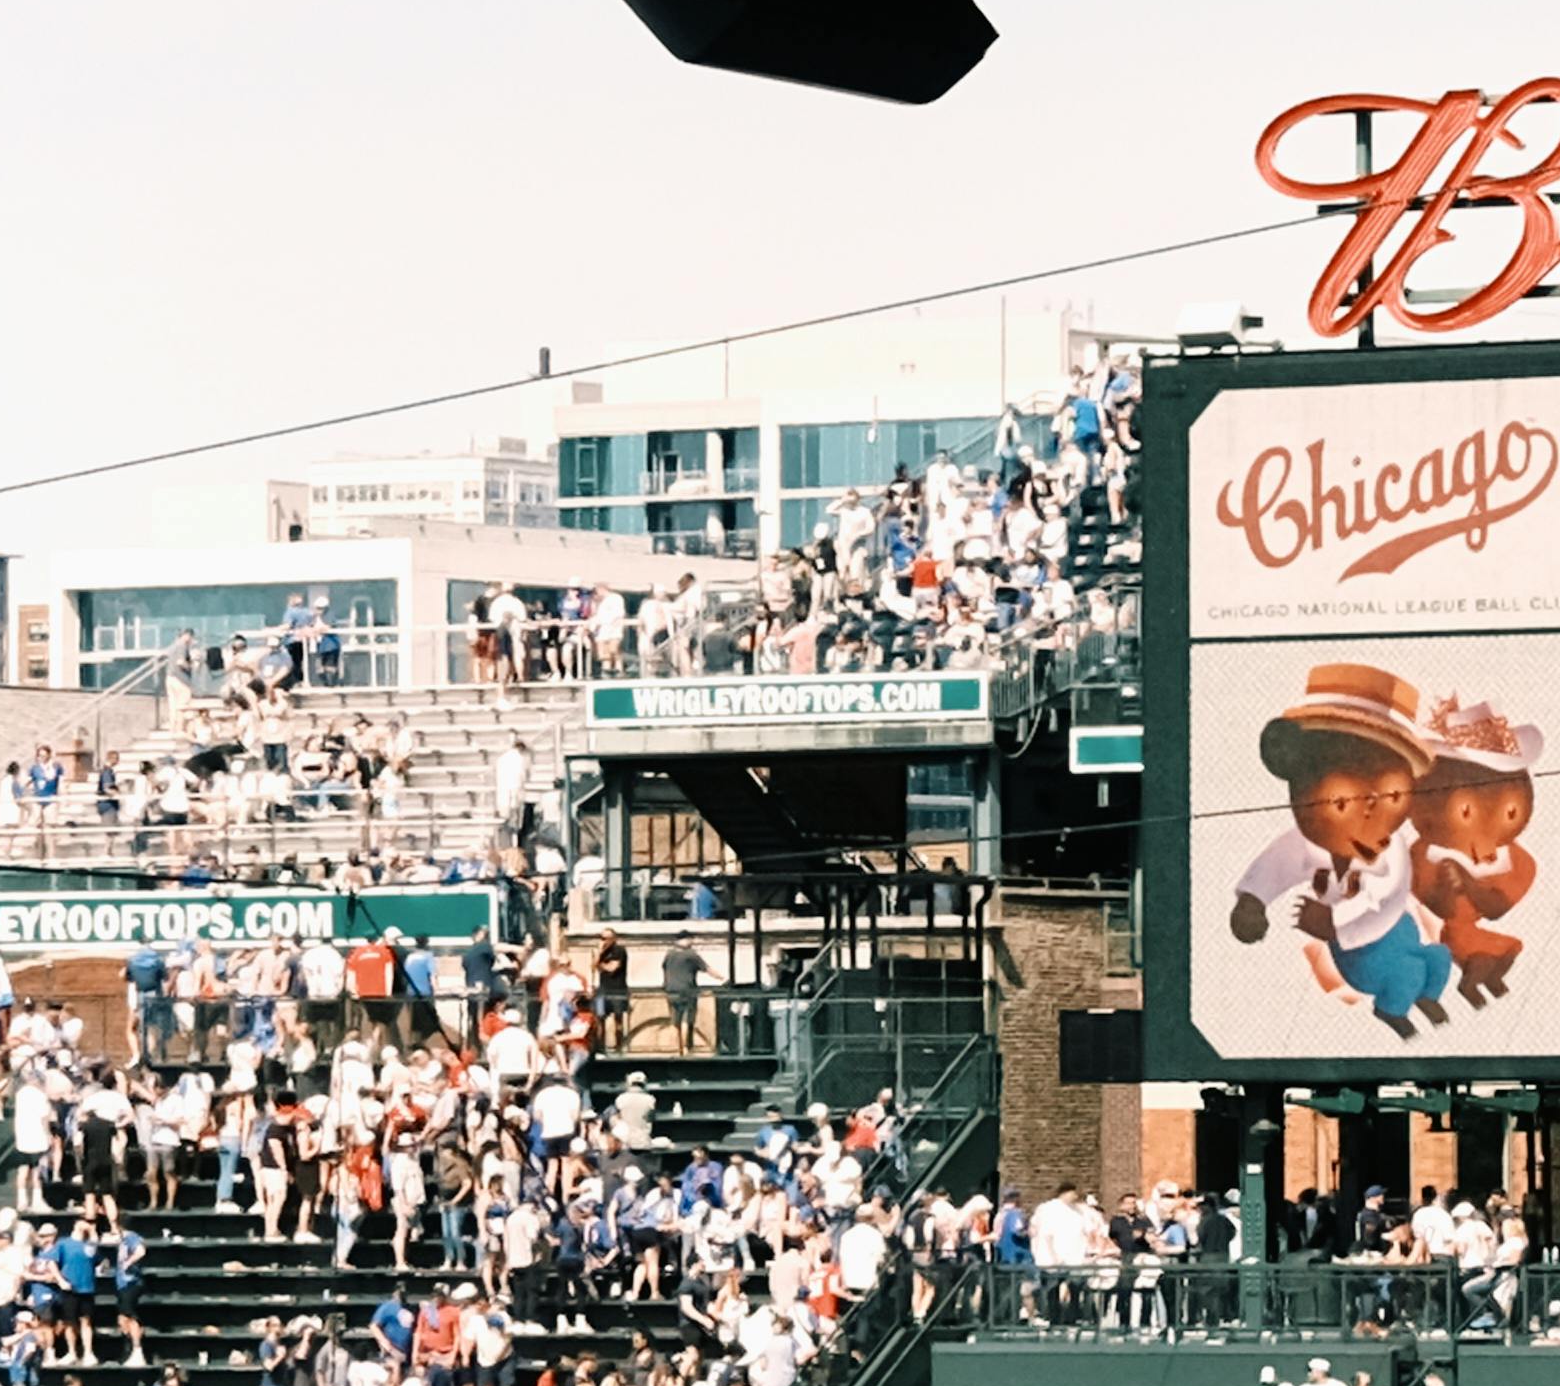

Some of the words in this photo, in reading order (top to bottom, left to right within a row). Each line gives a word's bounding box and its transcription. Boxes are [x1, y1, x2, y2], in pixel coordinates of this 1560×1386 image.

[1216, 421, 1559, 583] Chicago
[1207, 603, 1291, 621] CHICAGO
[1297, 599, 1388, 617] NATIONAL
[1394, 597, 1468, 615] LEAGUE
[1475, 596, 1520, 613] BALL
[633, 682, 941, 718] WRIGLEYROOFTOPS.COM
